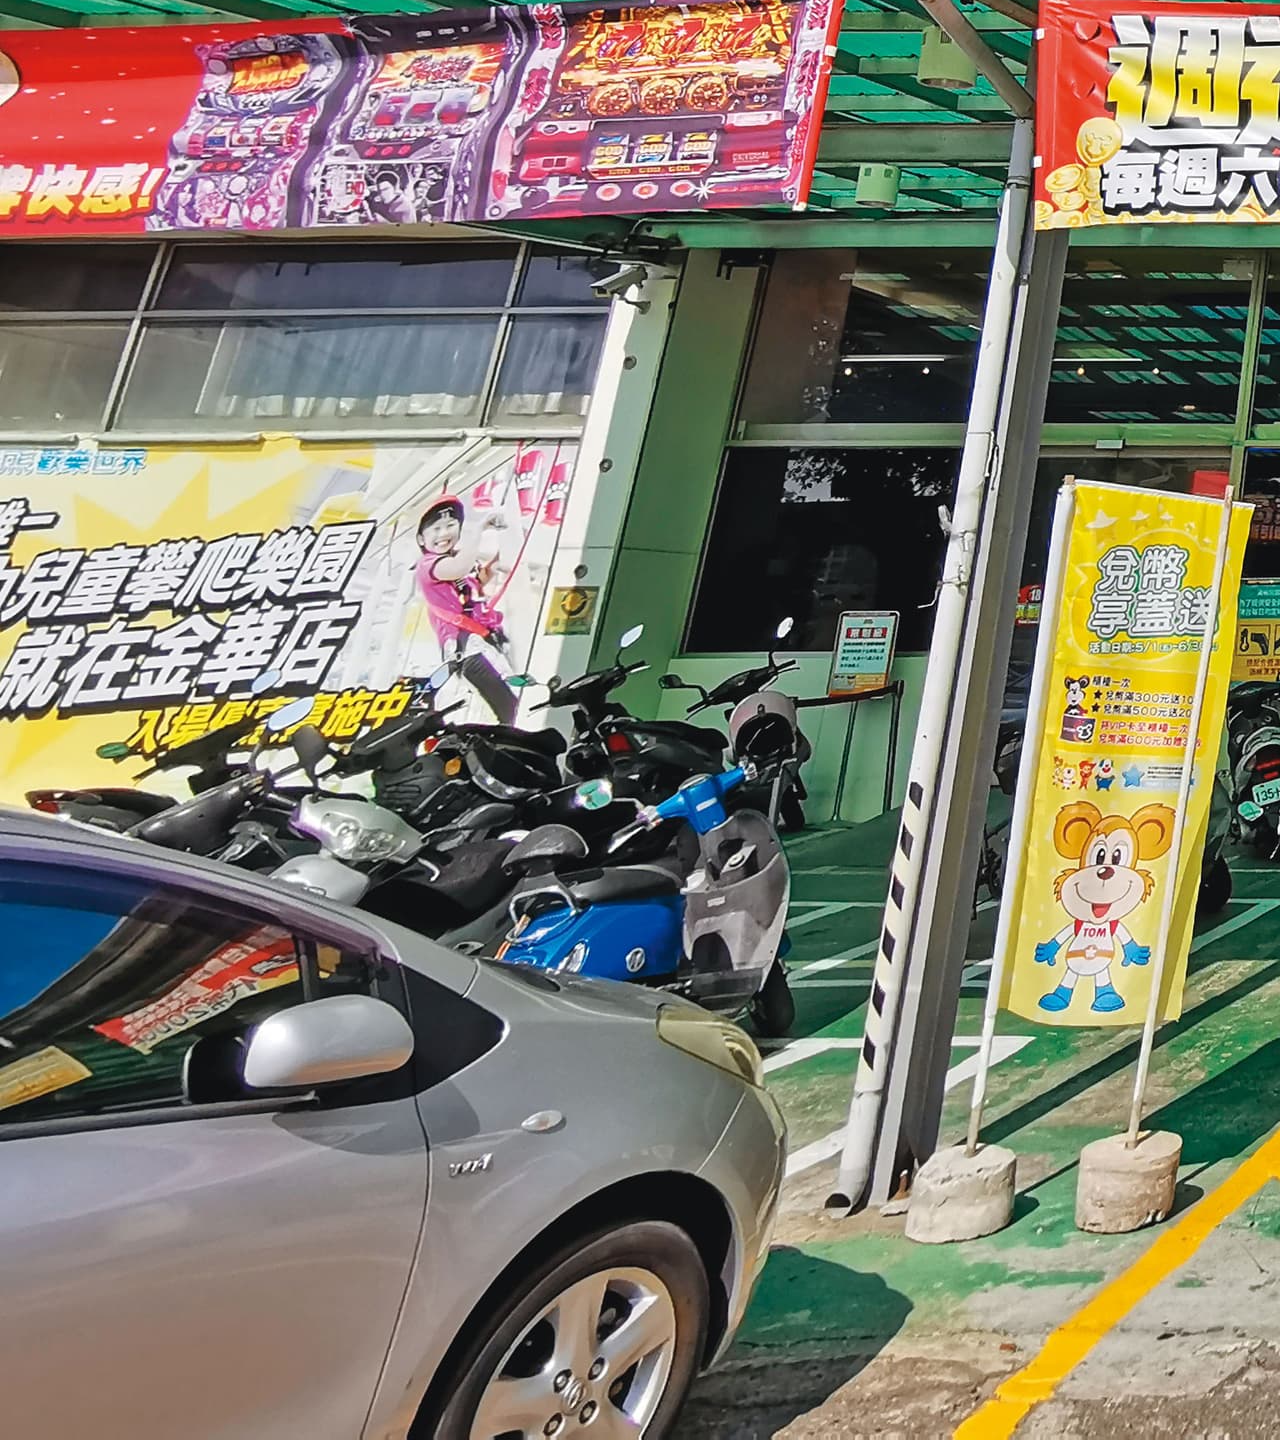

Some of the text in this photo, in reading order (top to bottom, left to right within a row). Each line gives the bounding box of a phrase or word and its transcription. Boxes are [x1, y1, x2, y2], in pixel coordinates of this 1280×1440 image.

[1097, 547, 1187, 592] 兌幣
[1105, 690, 1195, 705] 兌幣滿300元送10
[1103, 703, 1193, 718] 兌幣滿500元送20
[1083, 927, 1107, 939] TOM
